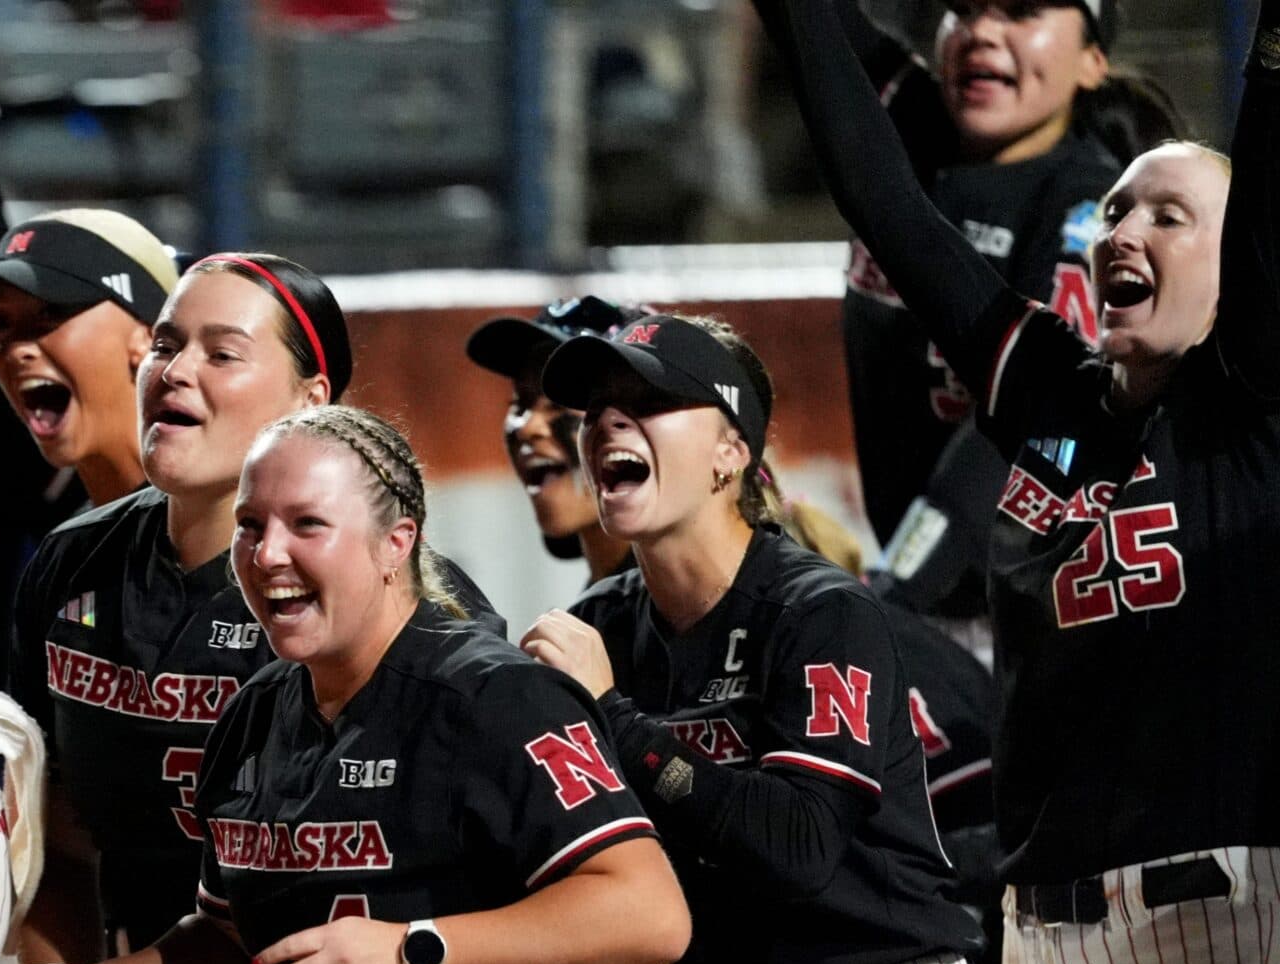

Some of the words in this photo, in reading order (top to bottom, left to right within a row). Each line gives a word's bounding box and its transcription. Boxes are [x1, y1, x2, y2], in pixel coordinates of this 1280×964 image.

[624, 324, 660, 344] N
[1052, 502, 1186, 629] 25
[45, 640, 241, 724] NEBRASKA
[724, 628, 748, 672] C
[805, 662, 871, 746] N
[525, 721, 626, 811] N
[207, 818, 393, 872] NEBRASKA
